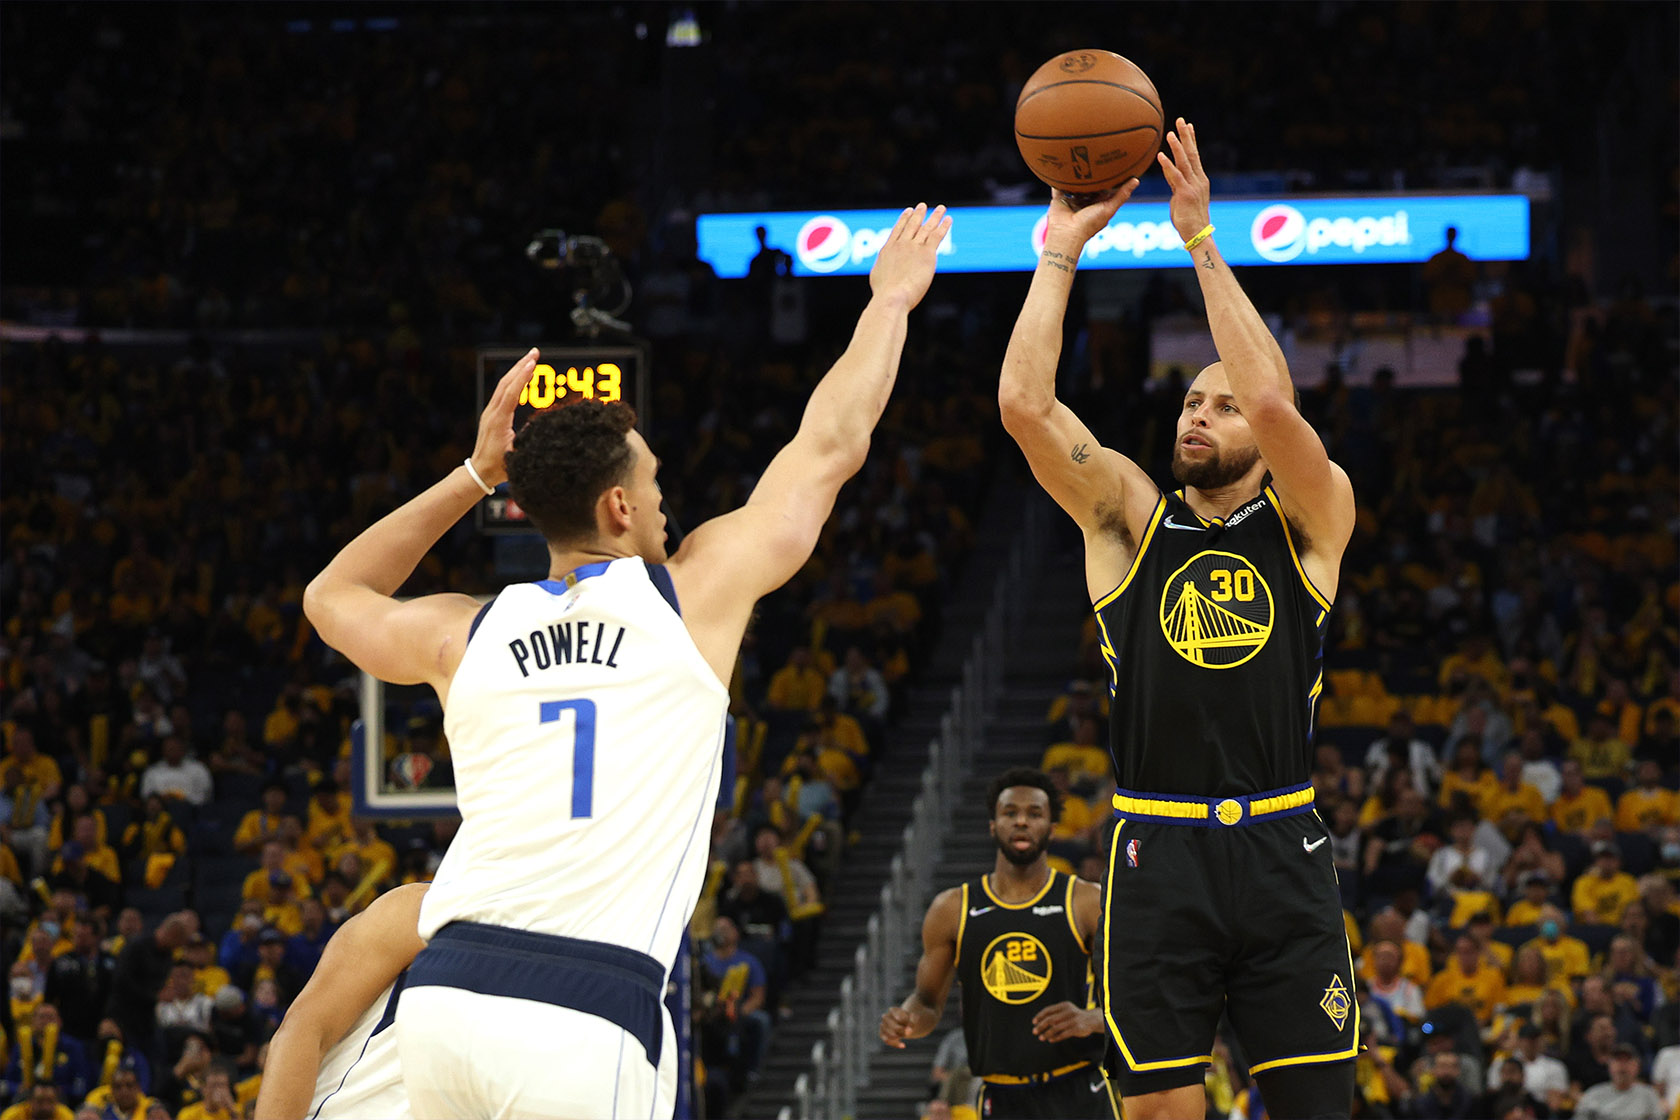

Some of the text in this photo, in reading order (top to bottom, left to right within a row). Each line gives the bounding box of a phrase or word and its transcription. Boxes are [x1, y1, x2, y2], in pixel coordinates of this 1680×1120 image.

[1085, 221, 1185, 259] peps
[1306, 210, 1411, 254] pepsi
[1210, 569, 1255, 602] 30
[509, 621, 626, 678] POWELL
[539, 698, 597, 820] 7
[1006, 940, 1037, 962] 22
